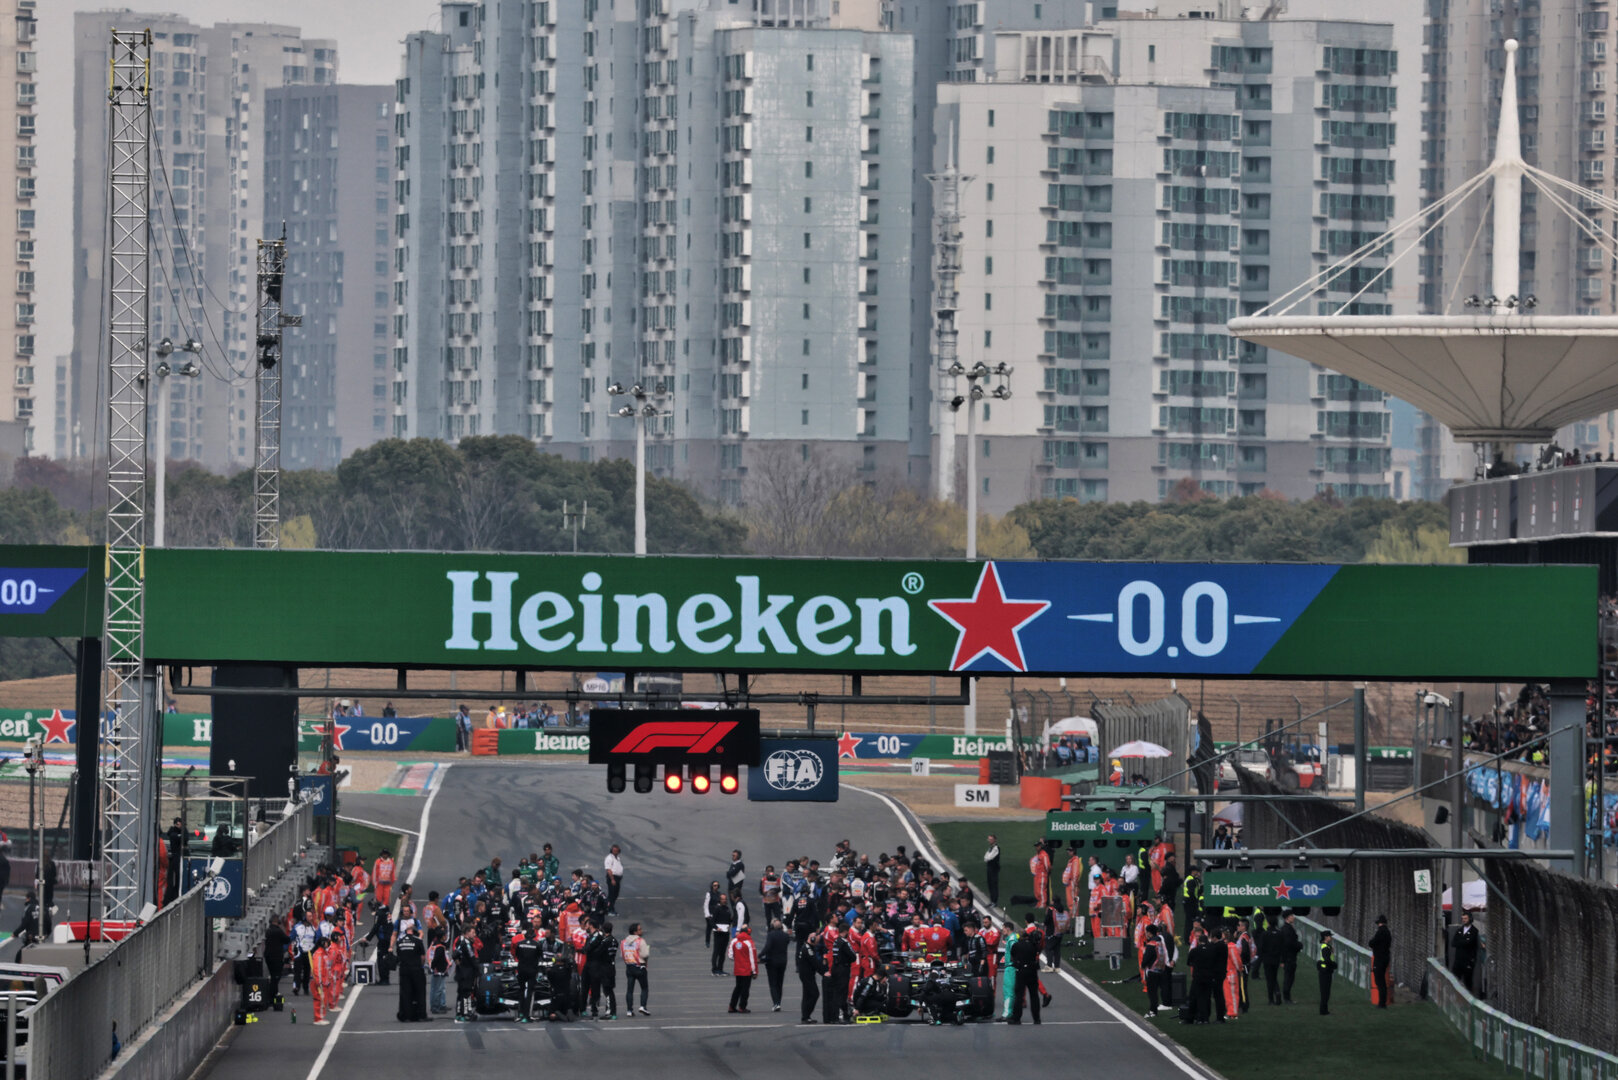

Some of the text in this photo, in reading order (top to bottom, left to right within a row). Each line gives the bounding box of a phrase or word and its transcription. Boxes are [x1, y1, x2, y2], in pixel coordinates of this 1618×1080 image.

[1, 579, 37, 606] 0.0
[1117, 580, 1229, 658] 0.0
[914, 761, 924, 773] OT
[965, 789, 990, 803] SM
[1051, 821, 1097, 831] Heineken
[1210, 884, 1270, 896] Heineken
[249, 990, 262, 1002] 16
